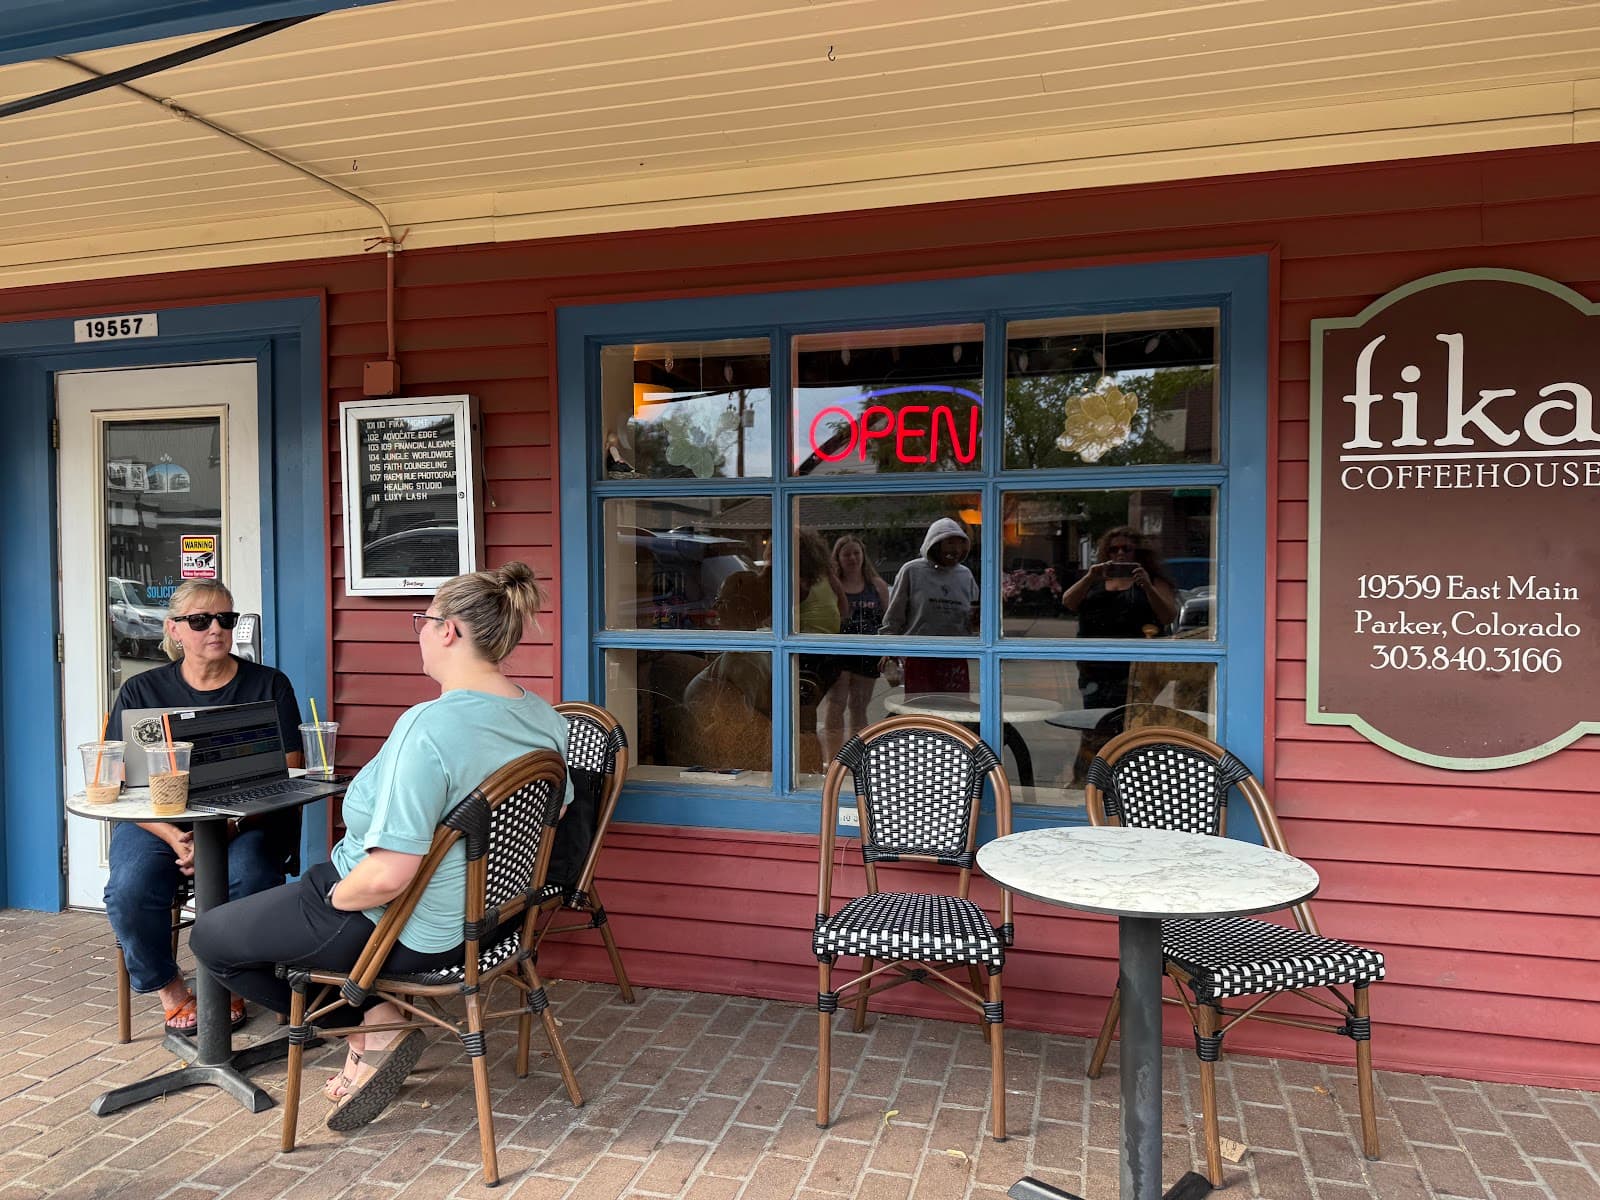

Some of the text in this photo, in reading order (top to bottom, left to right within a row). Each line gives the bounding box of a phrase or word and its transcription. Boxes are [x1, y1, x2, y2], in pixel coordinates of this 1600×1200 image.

[86, 318, 143, 338] 19557
[1342, 332, 1600, 450] fika
[367, 430, 438, 442] 102 ADVOCATE EDGE
[808, 404, 979, 465] OPEN
[368, 443, 379, 451] 103
[394, 441, 427, 450] FINANCIAL
[382, 452, 409, 461] JUNGLE
[411, 450, 454, 460] WORLDWIDE
[369, 461, 447, 472] 105 FAITH COUNSELING
[370, 473, 381, 482] 107
[404, 472, 417, 480] RUE
[1341, 461, 1600, 490] COFFEEHOUSE
[384, 481, 442, 491] HEALING STUDIO
[371, 492, 427, 502] 111 LUXY LASH
[185, 540, 213, 549] WARNING
[1357, 574, 1580, 600] 19559 East Main
[1354, 609, 1581, 639] Parker, Colorado
[1370, 645, 1563, 673] 303.840.3166
